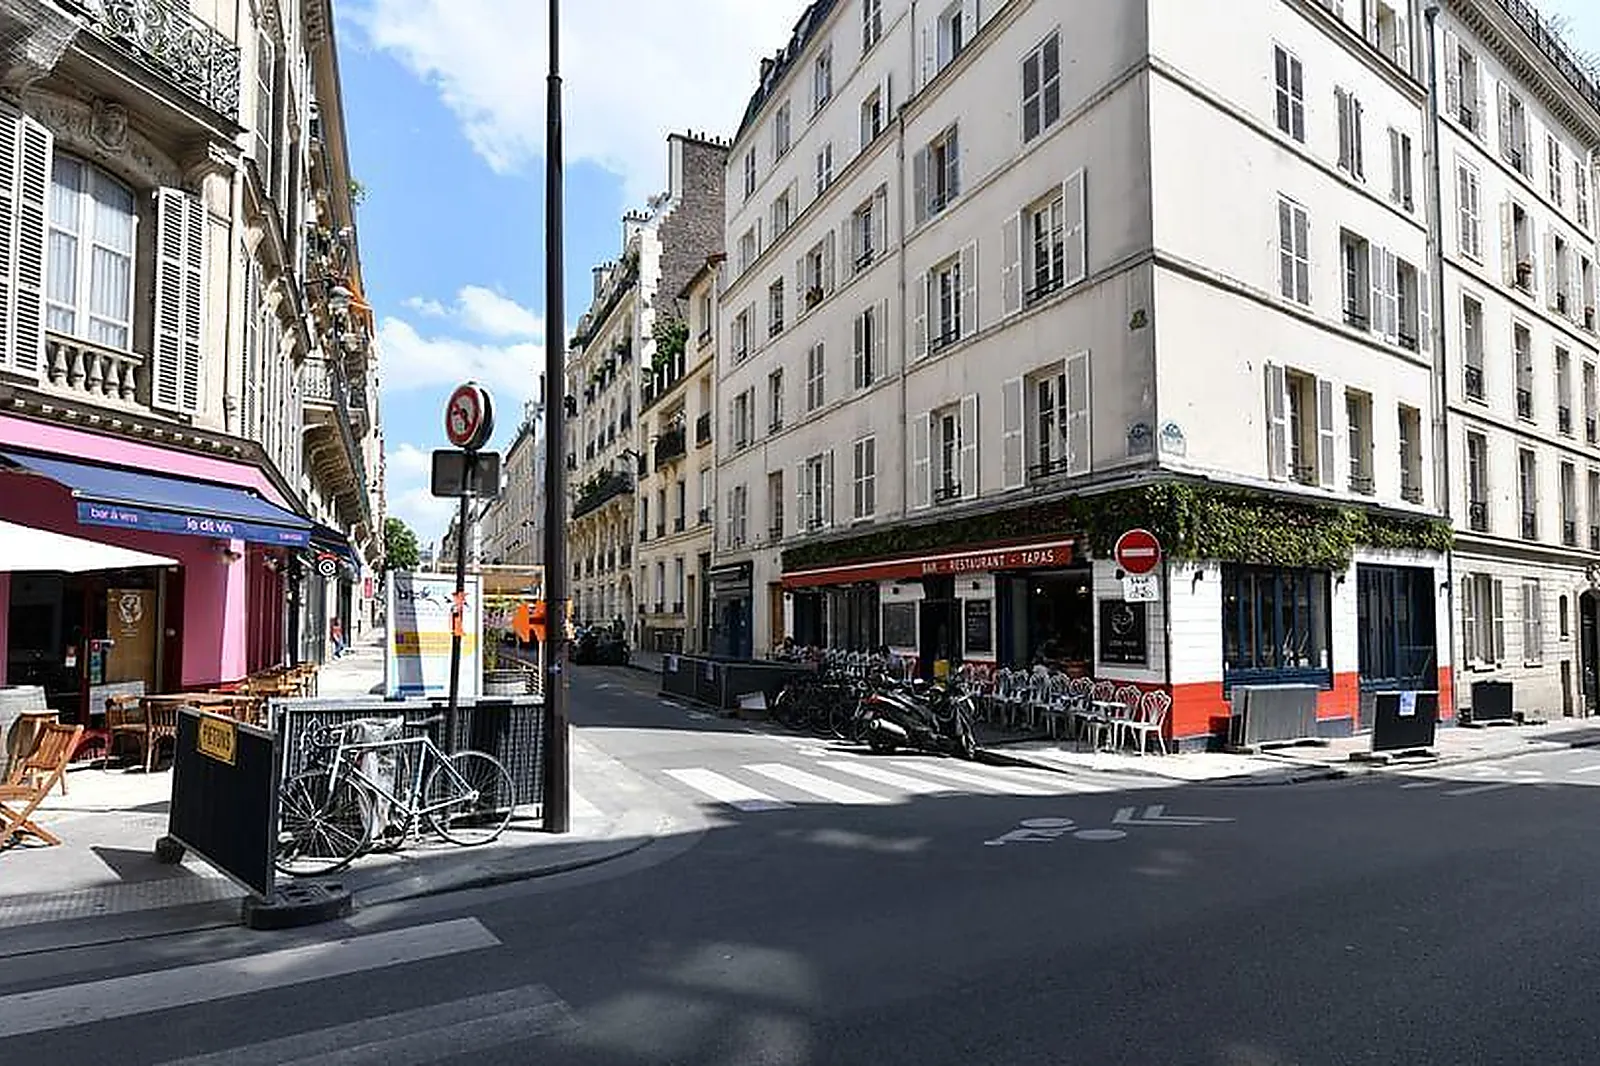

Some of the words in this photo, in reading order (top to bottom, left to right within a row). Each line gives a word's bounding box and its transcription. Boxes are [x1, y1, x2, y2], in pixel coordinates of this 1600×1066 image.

[921, 561, 937, 574] BAR
[949, 554, 1005, 571] RESTAURANT
[1021, 550, 1055, 563] TAPAS
